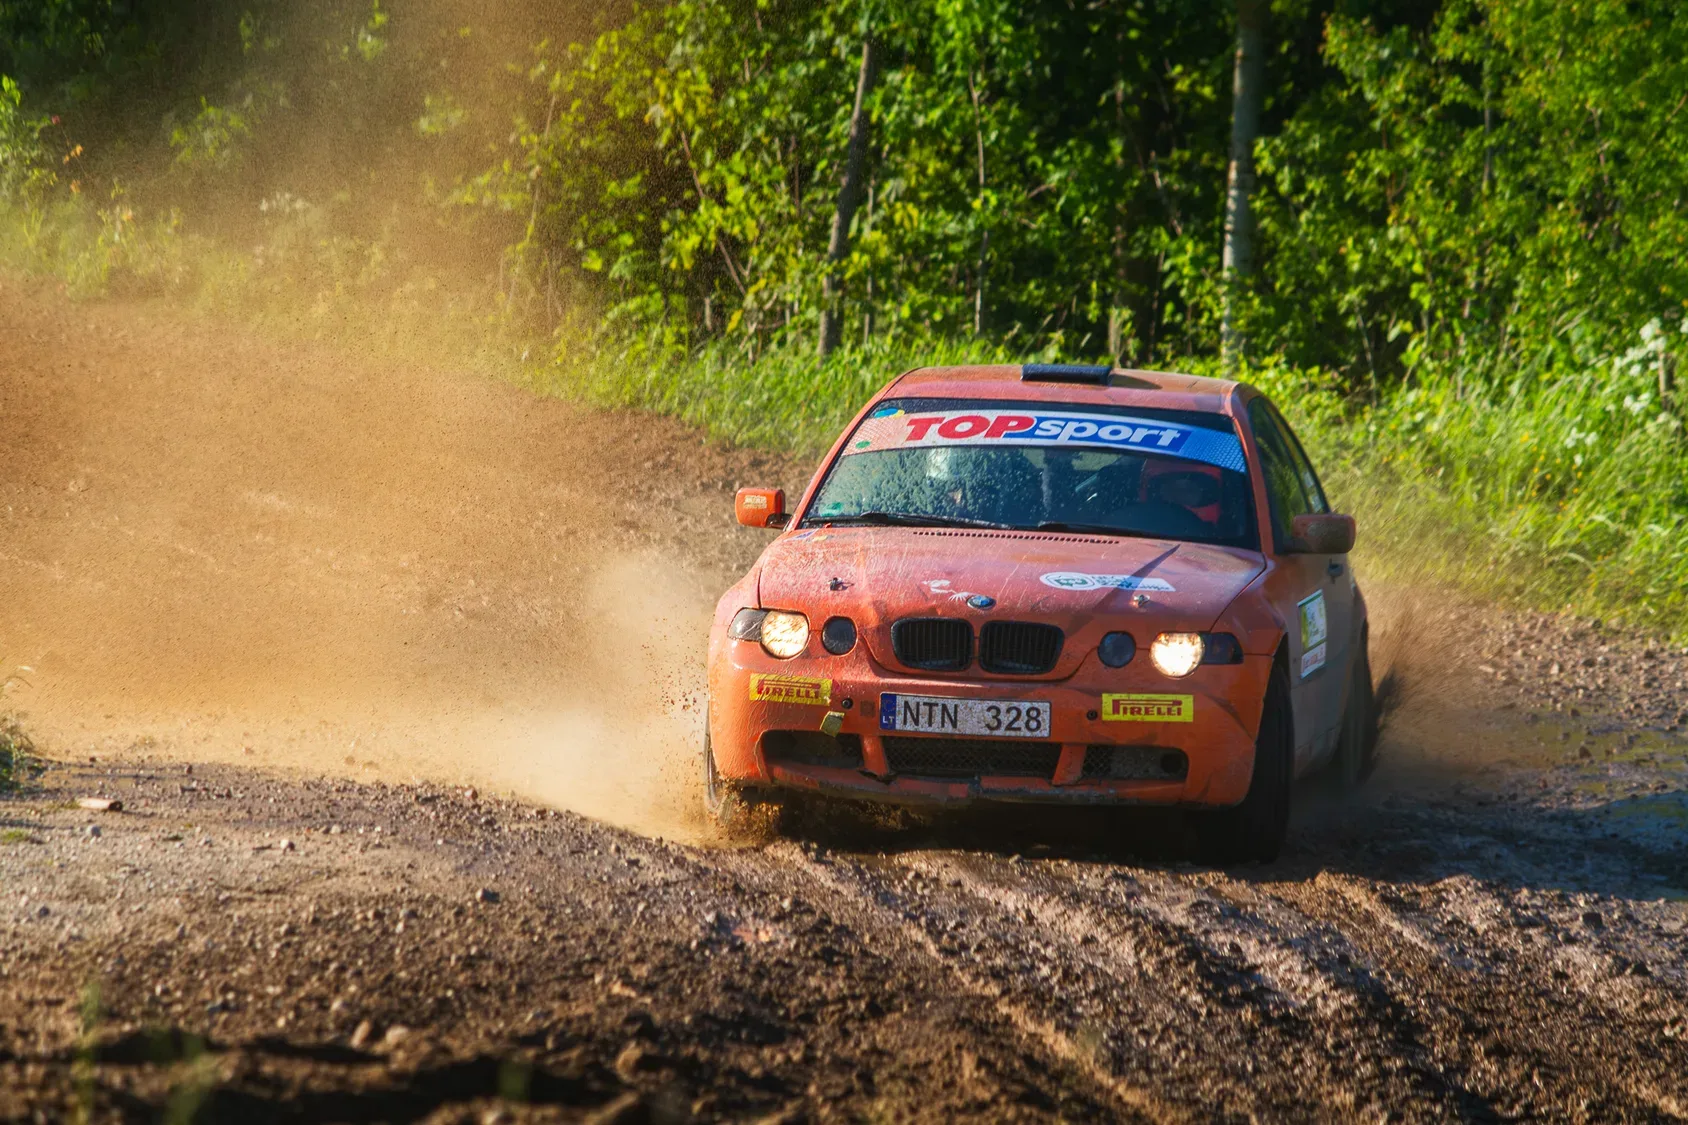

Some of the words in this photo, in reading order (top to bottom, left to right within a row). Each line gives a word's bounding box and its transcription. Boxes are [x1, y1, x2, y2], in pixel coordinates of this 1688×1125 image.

[757, 679, 821, 699] PIRELLI
[903, 700, 958, 729] NTN
[985, 705, 1042, 733] 328
[1112, 699, 1183, 716] PIRELLI
[882, 715, 895, 724] LT
